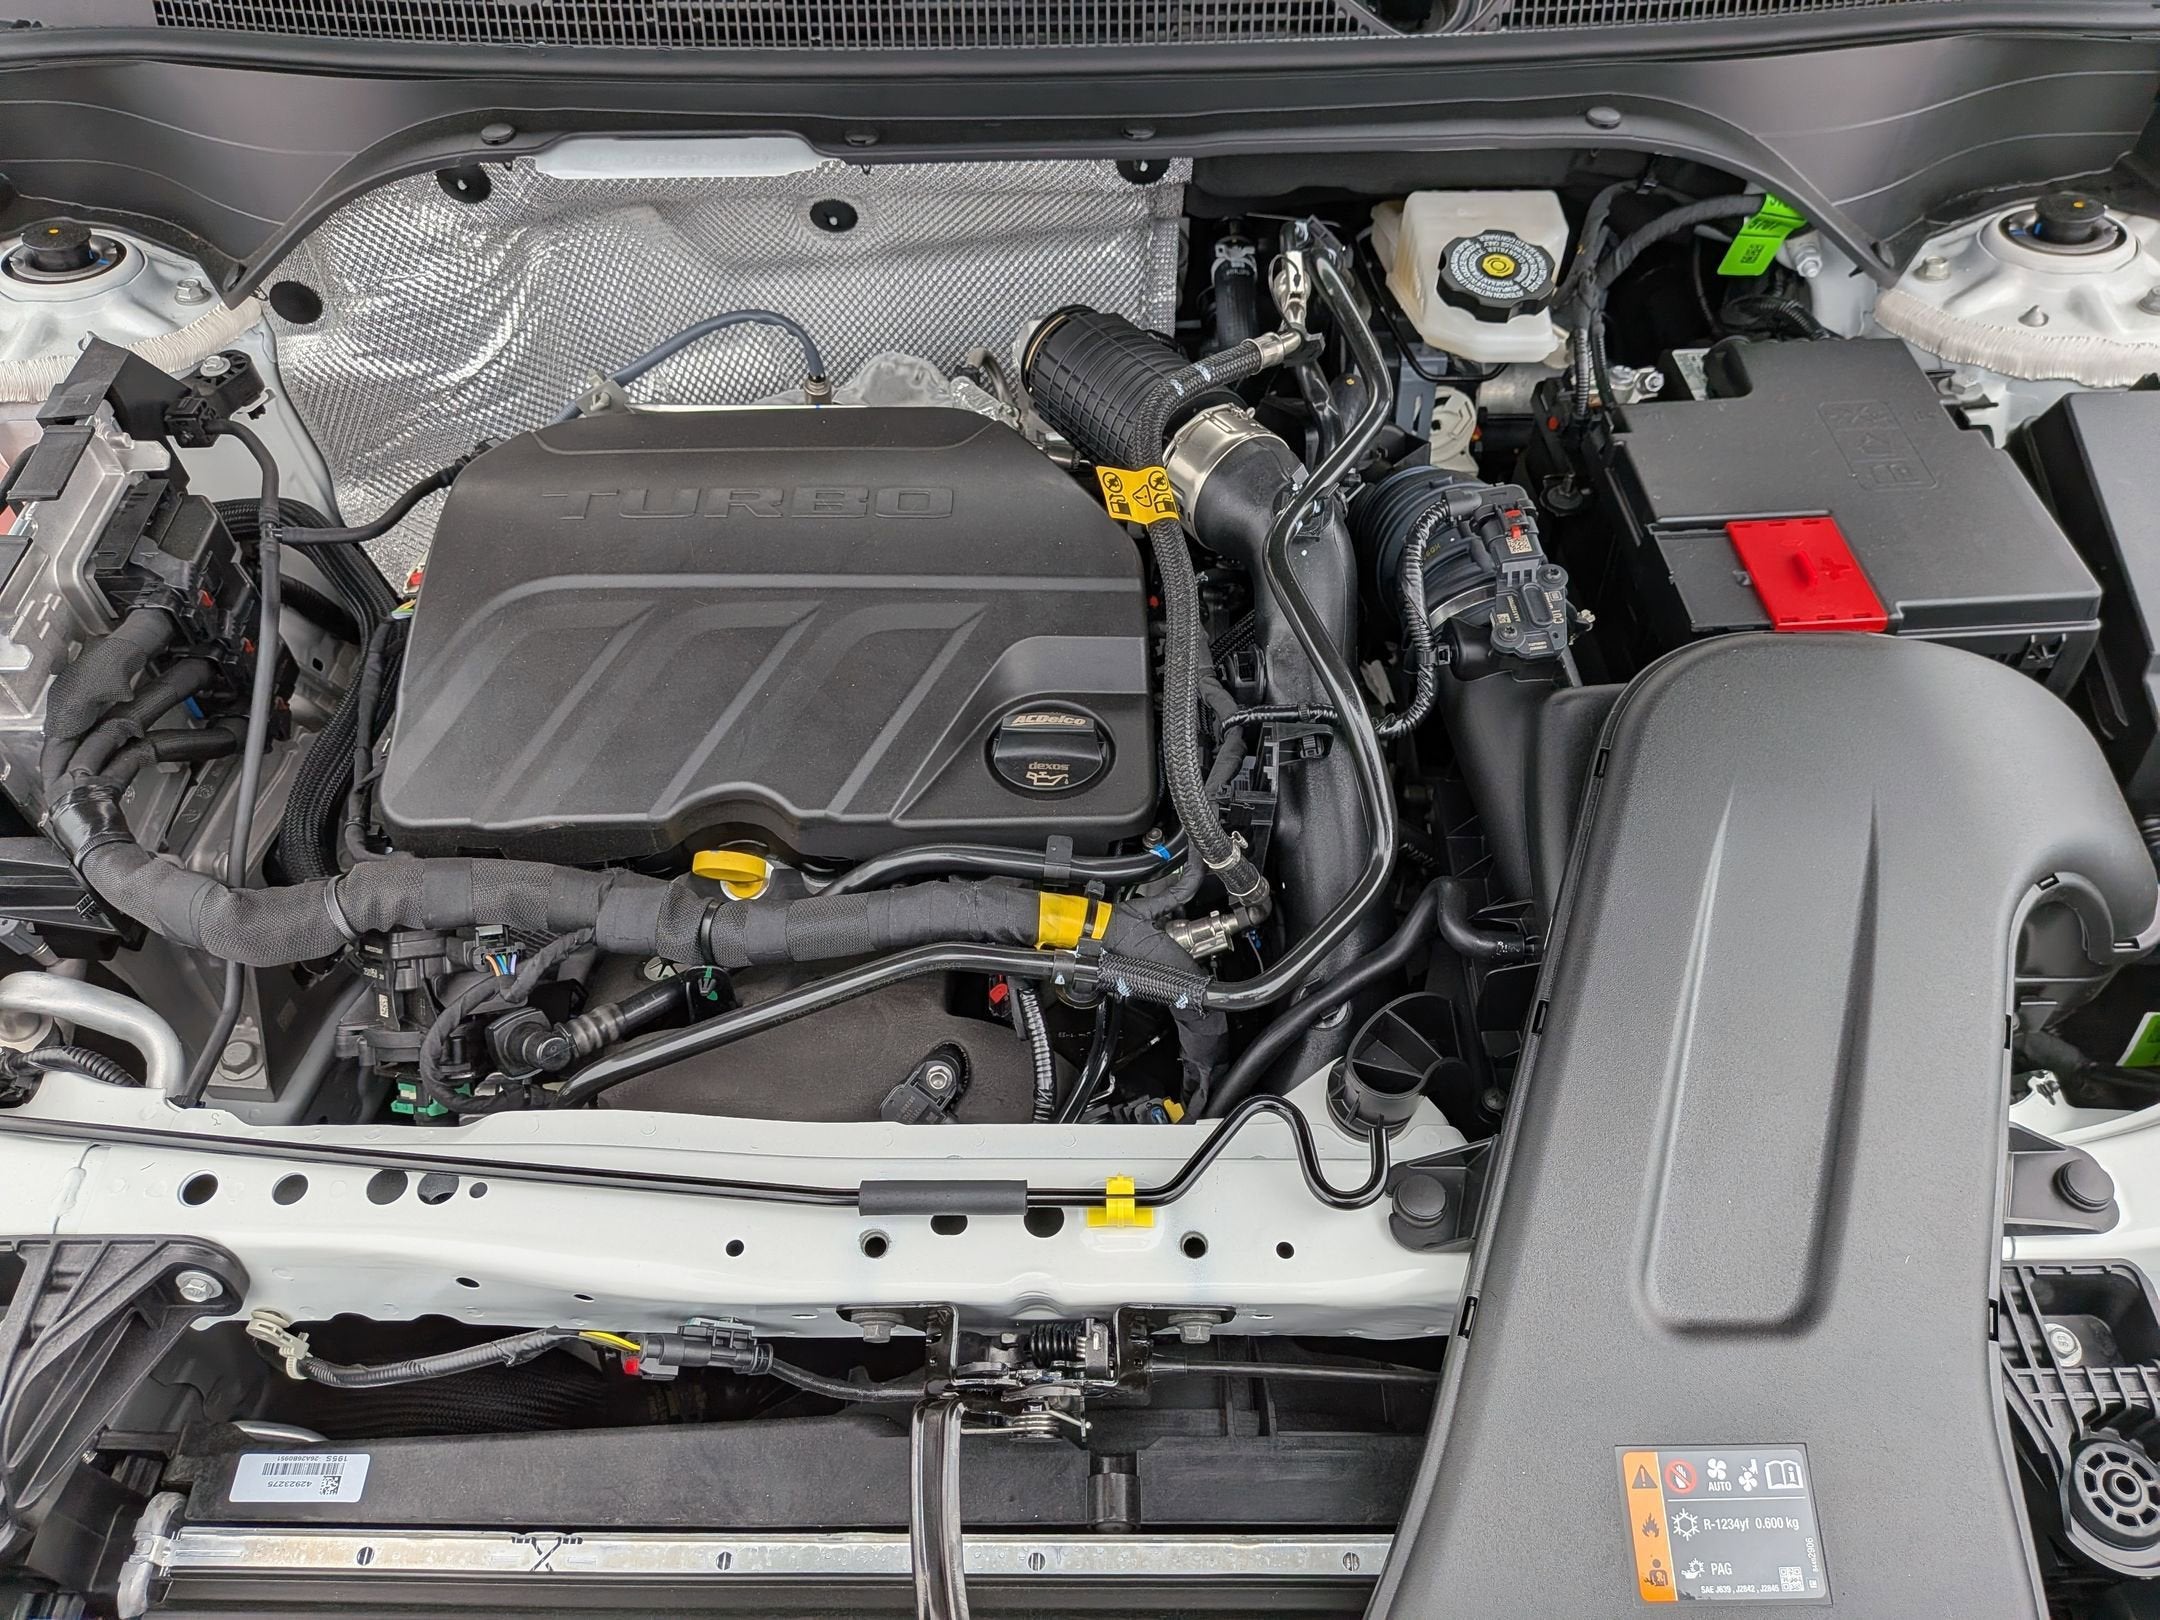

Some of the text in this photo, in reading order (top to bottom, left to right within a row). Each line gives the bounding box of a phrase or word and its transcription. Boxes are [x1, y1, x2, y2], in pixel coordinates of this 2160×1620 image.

[541, 487, 955, 520] TURBO
[1011, 715, 1087, 727] ACDelco
[1028, 762, 1069, 771] dexos
[267, 1480, 313, 1488] 42923275
[1708, 1481, 1732, 1492] AUTO
[1703, 1517, 1800, 1532] R-1234yf 0.600 kg
[1710, 1562, 1733, 1576] PAG
[1701, 1585, 1714, 1594] SAE
